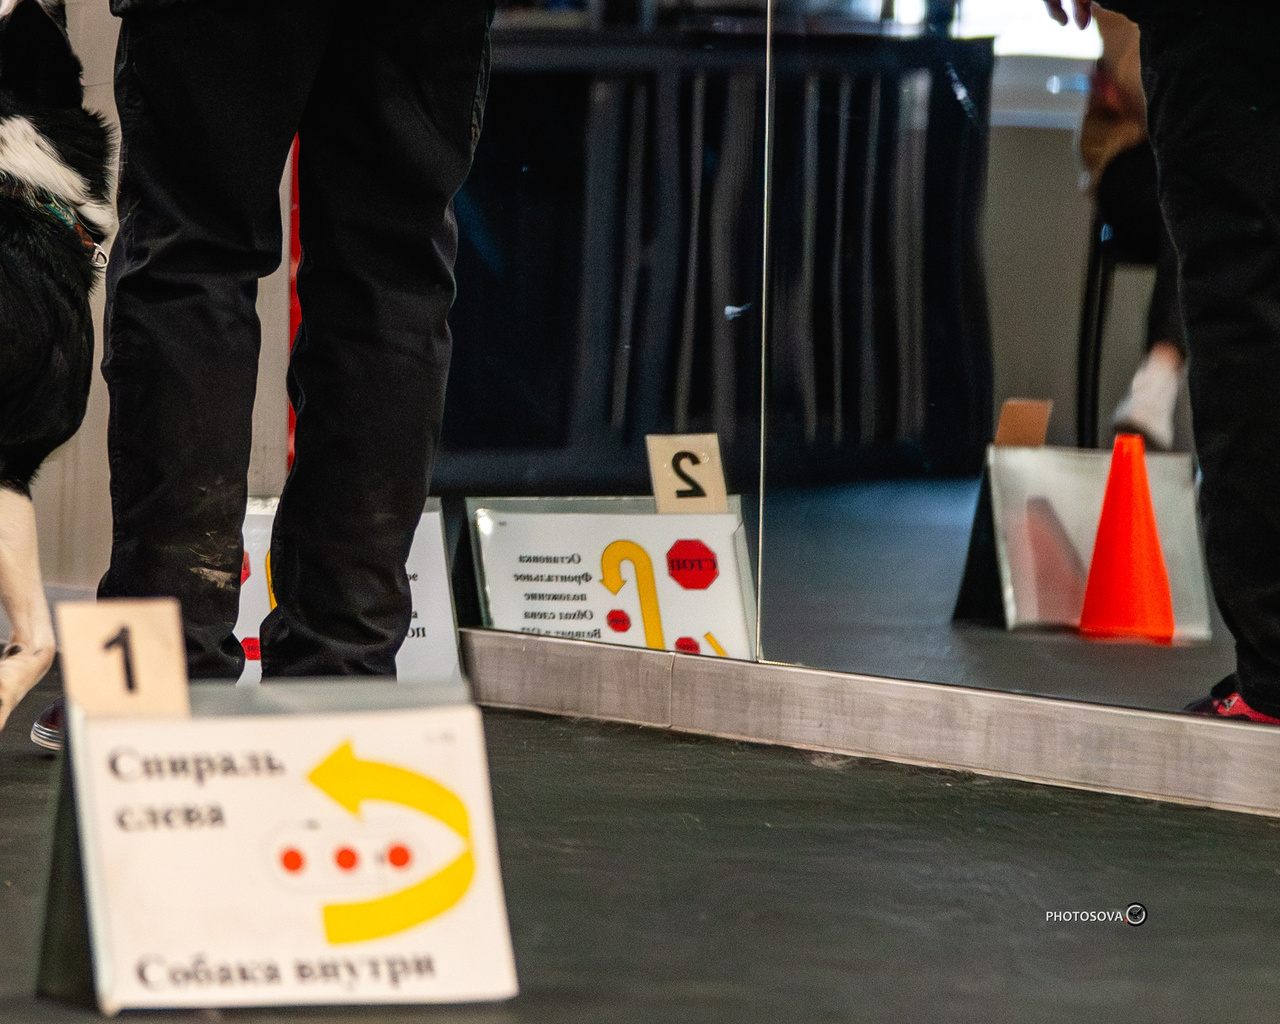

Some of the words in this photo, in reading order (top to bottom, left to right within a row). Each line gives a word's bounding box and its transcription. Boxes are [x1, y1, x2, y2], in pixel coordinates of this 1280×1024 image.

[102, 625, 137, 694] 1
[107, 747, 286, 786] Спираль
[115, 803, 226, 832] слева
[135, 952, 281, 991] Собака
[295, 953, 436, 991] внутри
